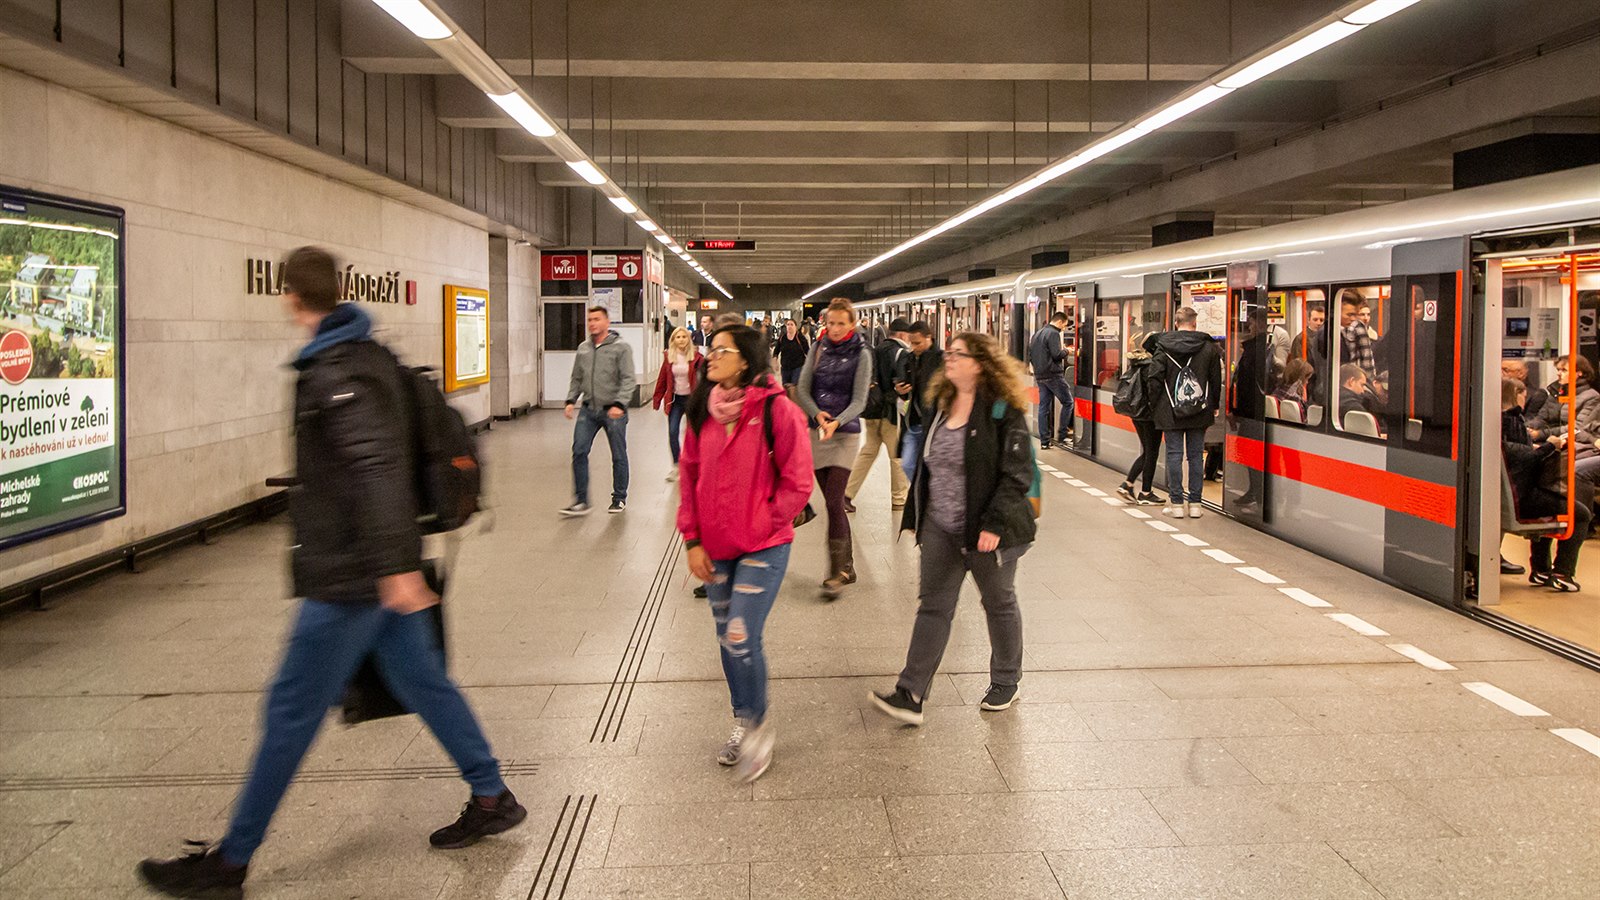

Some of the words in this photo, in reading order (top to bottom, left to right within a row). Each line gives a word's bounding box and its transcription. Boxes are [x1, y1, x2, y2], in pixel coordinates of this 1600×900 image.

[554, 265, 575, 274] WiFi
[626, 263, 632, 275] 1
[0, 386, 71, 414] Prémiové
[0, 413, 56, 445] bydlení
[60, 418, 68, 432] v
[0, 447, 7, 461] k
[78, 438, 84, 446] v
[84, 431, 109, 446] lednu!
[0, 474, 41, 495] Michelské
[0, 490, 31, 508] zahrady
